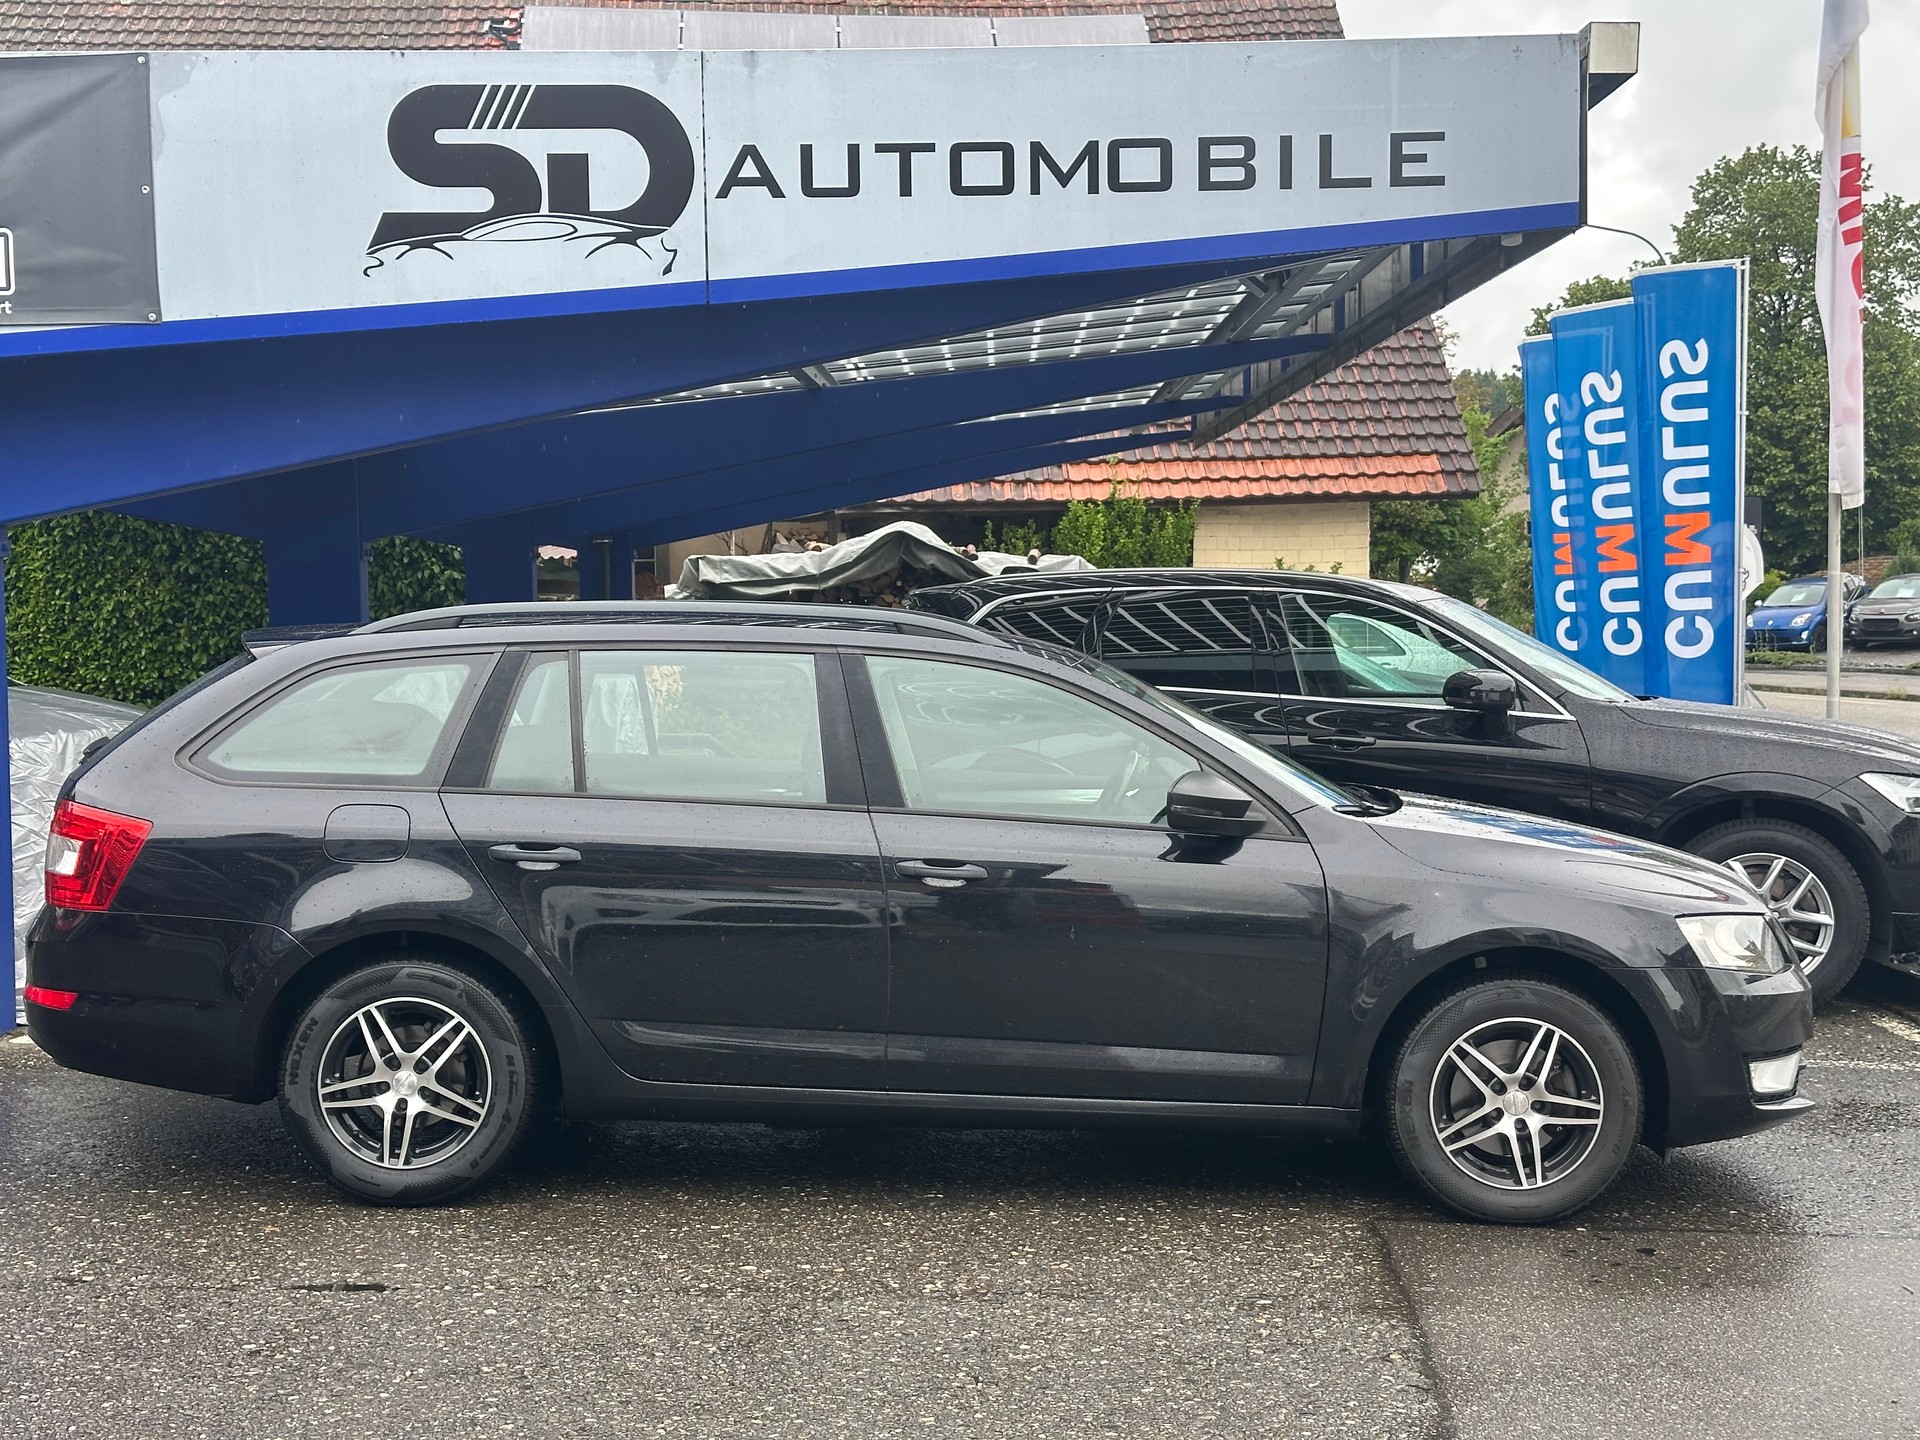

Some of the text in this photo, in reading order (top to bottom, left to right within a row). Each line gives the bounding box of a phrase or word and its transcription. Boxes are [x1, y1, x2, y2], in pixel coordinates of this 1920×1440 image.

[367, 84, 695, 251] SD
[715, 131, 1447, 199] AUTOMOBILE
[288, 1016, 319, 1086] NEXEN
[1402, 1079, 1421, 1150] NEXEN
